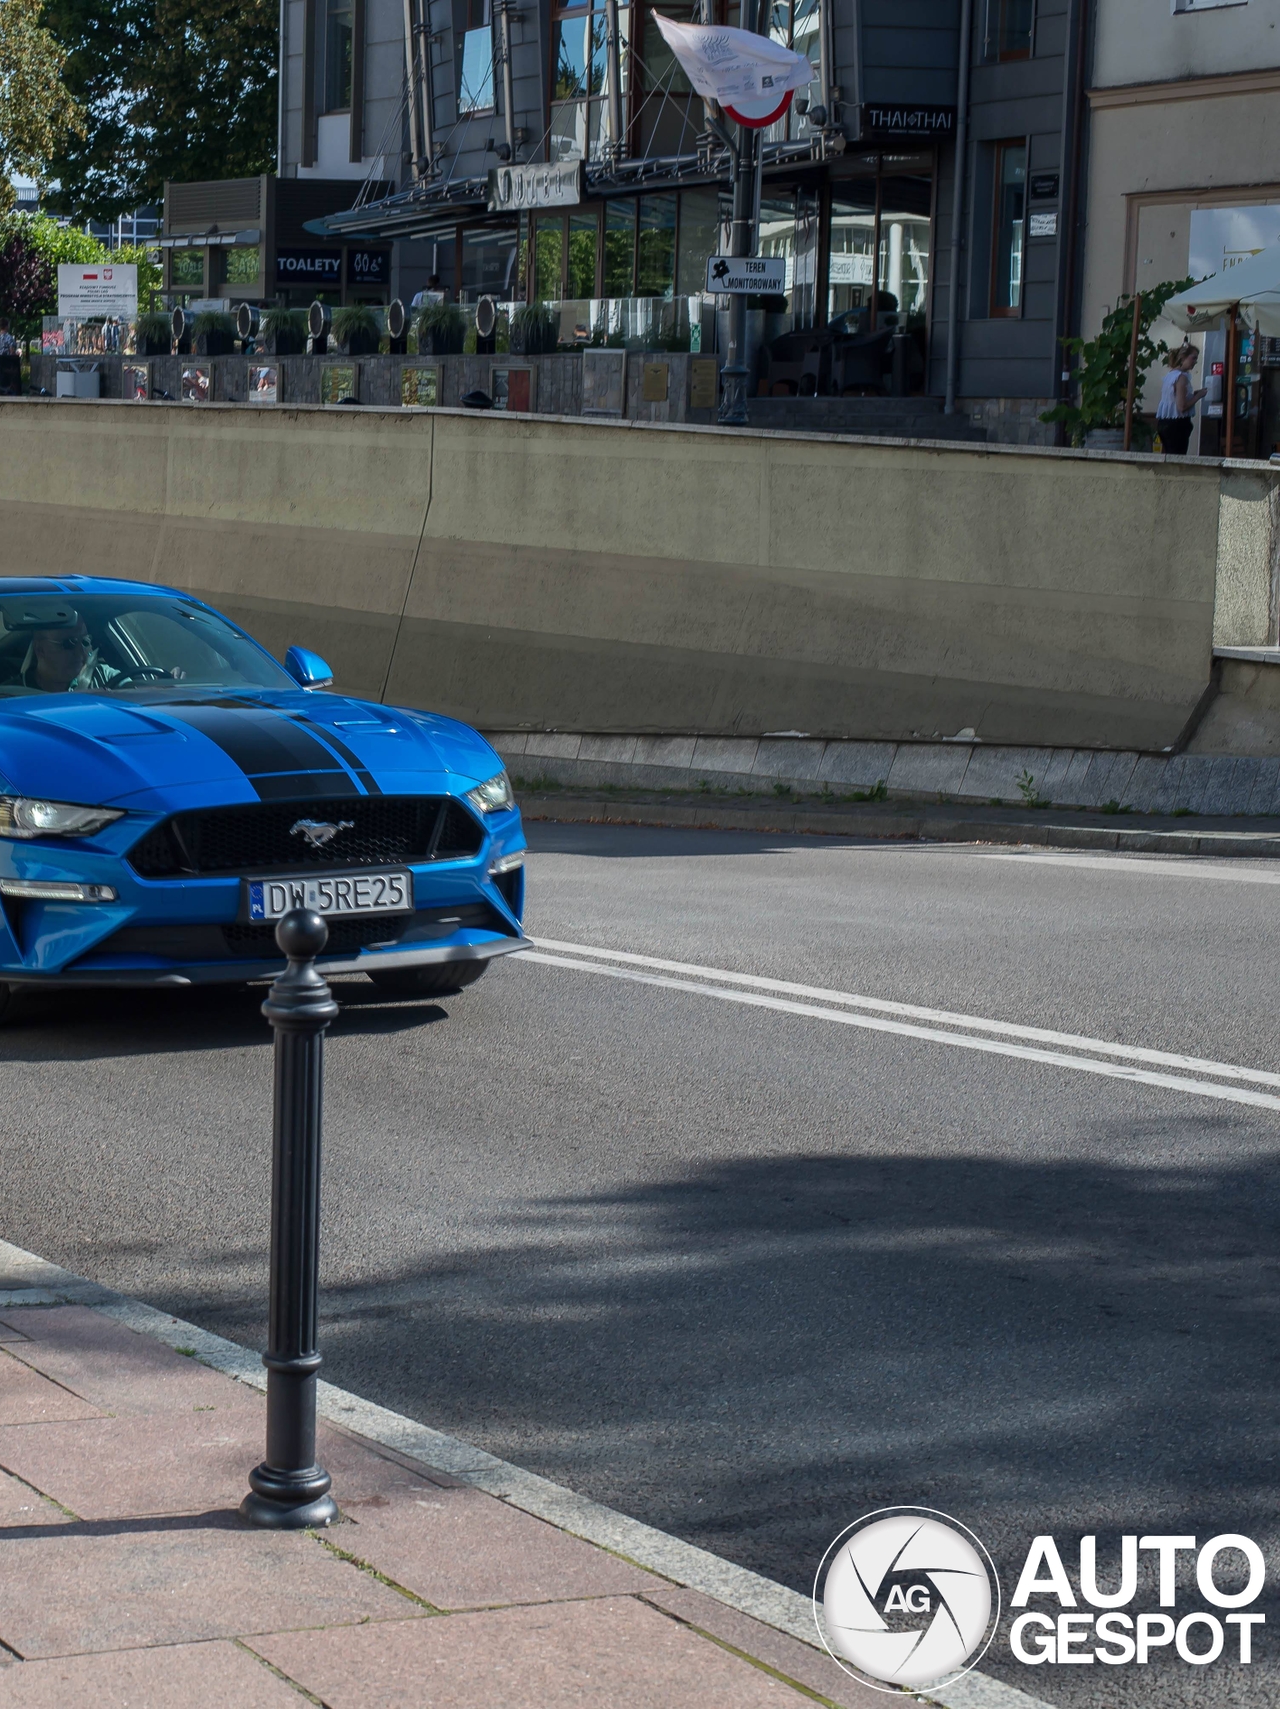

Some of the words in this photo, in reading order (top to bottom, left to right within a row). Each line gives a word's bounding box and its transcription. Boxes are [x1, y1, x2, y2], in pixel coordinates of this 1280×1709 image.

[869, 109, 907, 128] THAI
[914, 111, 952, 129] THAI
[277, 257, 341, 272] TOALETY
[745, 262, 767, 273] TEREN
[728, 277, 782, 290] MONITOROWANY
[269, 880, 307, 914] DW
[317, 873, 406, 910] 5RE25
